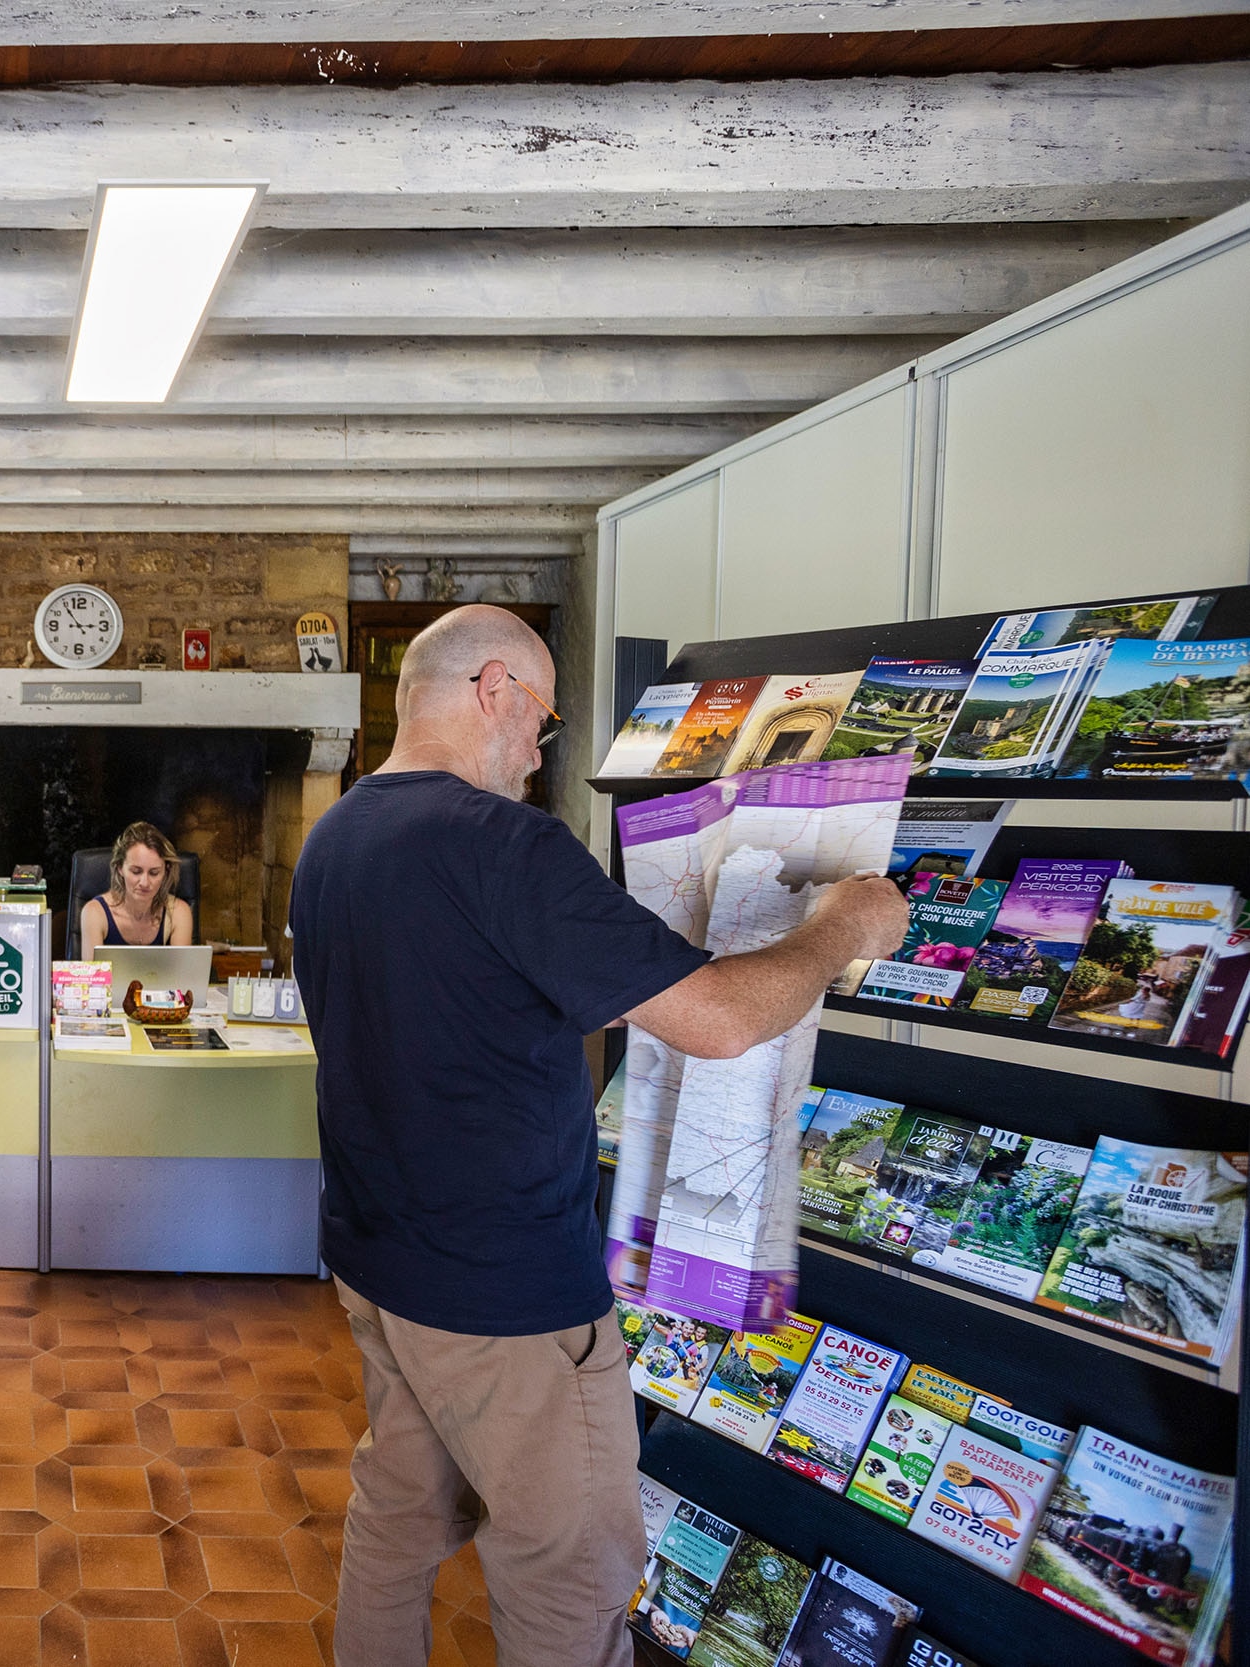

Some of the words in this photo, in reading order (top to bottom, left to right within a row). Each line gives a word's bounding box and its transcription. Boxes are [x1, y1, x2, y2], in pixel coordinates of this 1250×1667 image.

[72, 598, 87, 609] 12
[49, 620, 59, 631] 9
[99, 620, 109, 632] 3
[300, 619, 327, 633] D704
[74, 643, 84, 655] 6
[299, 637, 318, 646] SARLAT
[1156, 642, 1248, 652] GABARRES
[1152, 652, 1178, 661] DE
[1181, 650, 1250, 661] BEYNA
[908, 667, 922, 675] LE
[981, 657, 1075, 673] COMMARQUE
[51, 684, 111, 701] Bienvenue
[1051, 863, 1084, 871] 2026
[1023, 872, 1083, 882] VISITES
[1084, 874, 1107, 883] EN
[1019, 882, 1102, 893] PÉRIGORD
[918, 903, 988, 920] CHOCOLATERIE
[1122, 899, 1149, 910] PLAN
[1153, 901, 1169, 912] DE
[1173, 902, 1207, 915] VILLE
[920, 912, 939, 922] SON
[943, 916, 977, 928] MUSÉE
[878, 964, 906, 974] VOYAGE
[908, 968, 950, 980] GOURMAND
[888, 972, 907, 981] PAYS
[922, 978, 948, 988] CACAO
[281, 988, 295, 1012] 6
[981, 990, 1018, 1000] PASS
[827, 1095, 894, 1120] Eyrignac
[918, 1126, 964, 1144] JARDINS
[938, 1125, 949, 1133] Les
[910, 1135, 963, 1152] d'eau
[1038, 1140, 1053, 1149] Les
[1055, 1142, 1090, 1156] Jardins
[1035, 1150, 1073, 1171] Cadiot
[1056, 1152, 1068, 1161] de
[803, 1185, 814, 1193] LE
[816, 1188, 835, 1199] PLUS
[1130, 1183, 1144, 1194] LA
[1147, 1186, 1182, 1201] ROQUE
[800, 1198, 841, 1216] PÉRIGORD
[813, 1195, 843, 1209] JARDIN
[1126, 1194, 1215, 1216] SAINT-CHRISTOPHE
[979, 1257, 1007, 1269] CARLUX
[1083, 1266, 1100, 1277] DES
[765, 1333, 794, 1351] CANOË
[823, 1336, 893, 1371] CANOË
[815, 1366, 874, 1396] DÉTENTE
[805, 1385, 816, 1395] 05
[817, 1390, 828, 1400] 53
[828, 1396, 840, 1405] 29
[840, 1401, 852, 1410] 52
[853, 1407, 864, 1416] 15
[975, 1411, 1012, 1431] DOMAINE
[1014, 1427, 1025, 1436] DE
[977, 1401, 1023, 1425] FOOT
[1025, 1421, 1070, 1443] GOLF
[903, 1454, 913, 1464] LA
[1087, 1446, 1112, 1460] CHEMIN
[1113, 1458, 1123, 1466] DE
[1124, 1463, 1137, 1472] FER
[1092, 1435, 1149, 1469] TRAIN
[1152, 1464, 1169, 1475] DE
[1171, 1471, 1231, 1495] MARTEL
[962, 1449, 1036, 1489] PARAPENTE
[1027, 1470, 1045, 1483] EN
[1093, 1460, 1106, 1472] UN
[1108, 1467, 1144, 1490] VOYAGE
[1145, 1484, 1171, 1502] PLEIN
[702, 1515, 731, 1535] ATELIER
[930, 1500, 1018, 1551] GOT2FLY
[925, 1517, 941, 1529] 07
[942, 1526, 957, 1538] 83
[959, 1534, 975, 1547] 39
[977, 1544, 994, 1556] 69
[995, 1553, 1012, 1565] 79
[665, 1571, 677, 1585] Le
[676, 1580, 700, 1598] moulin
[700, 1595, 711, 1604] de
